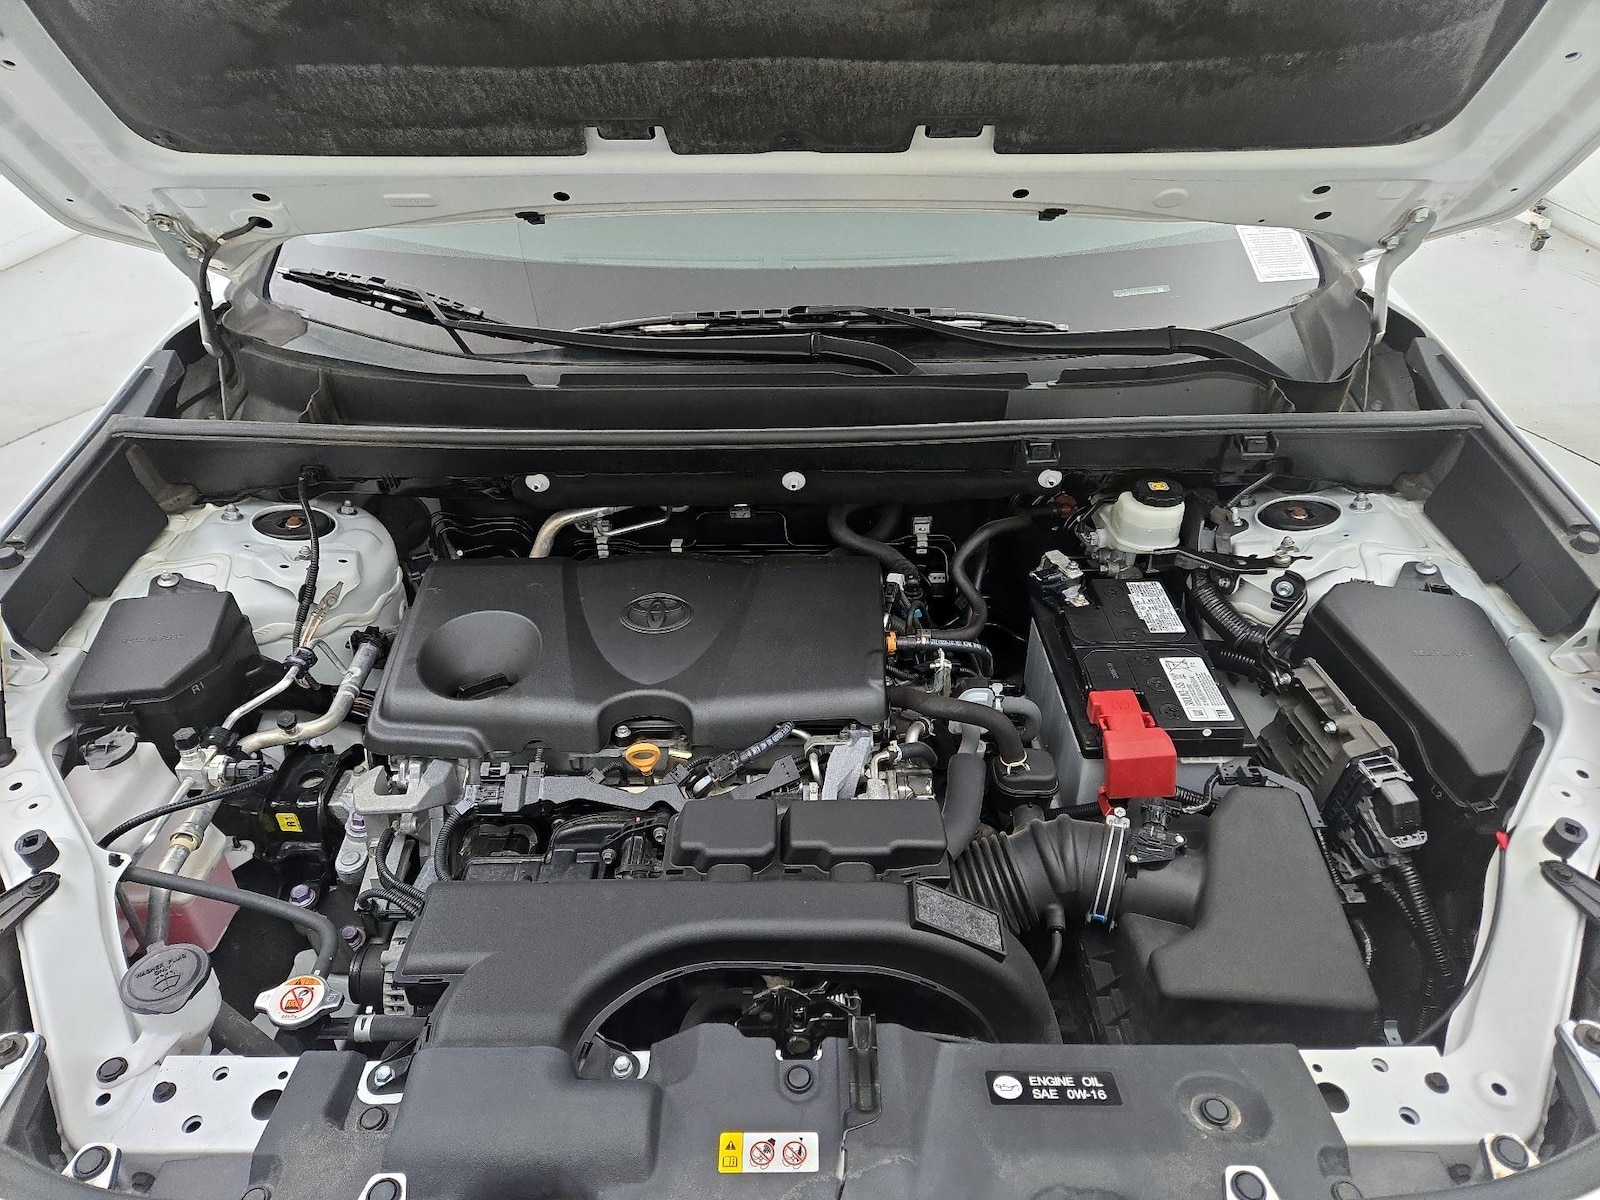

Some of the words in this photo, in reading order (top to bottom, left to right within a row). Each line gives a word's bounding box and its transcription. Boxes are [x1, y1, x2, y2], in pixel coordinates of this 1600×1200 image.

[190, 681, 205, 695] R1
[285, 816, 297, 827] R1
[134, 962, 164, 979] WASHER
[1028, 1075, 1076, 1087] ENGINE
[1081, 1075, 1105, 1088] OIL
[1031, 1088, 1060, 1100] SAE
[1066, 1089, 1108, 1100] 0W-16
